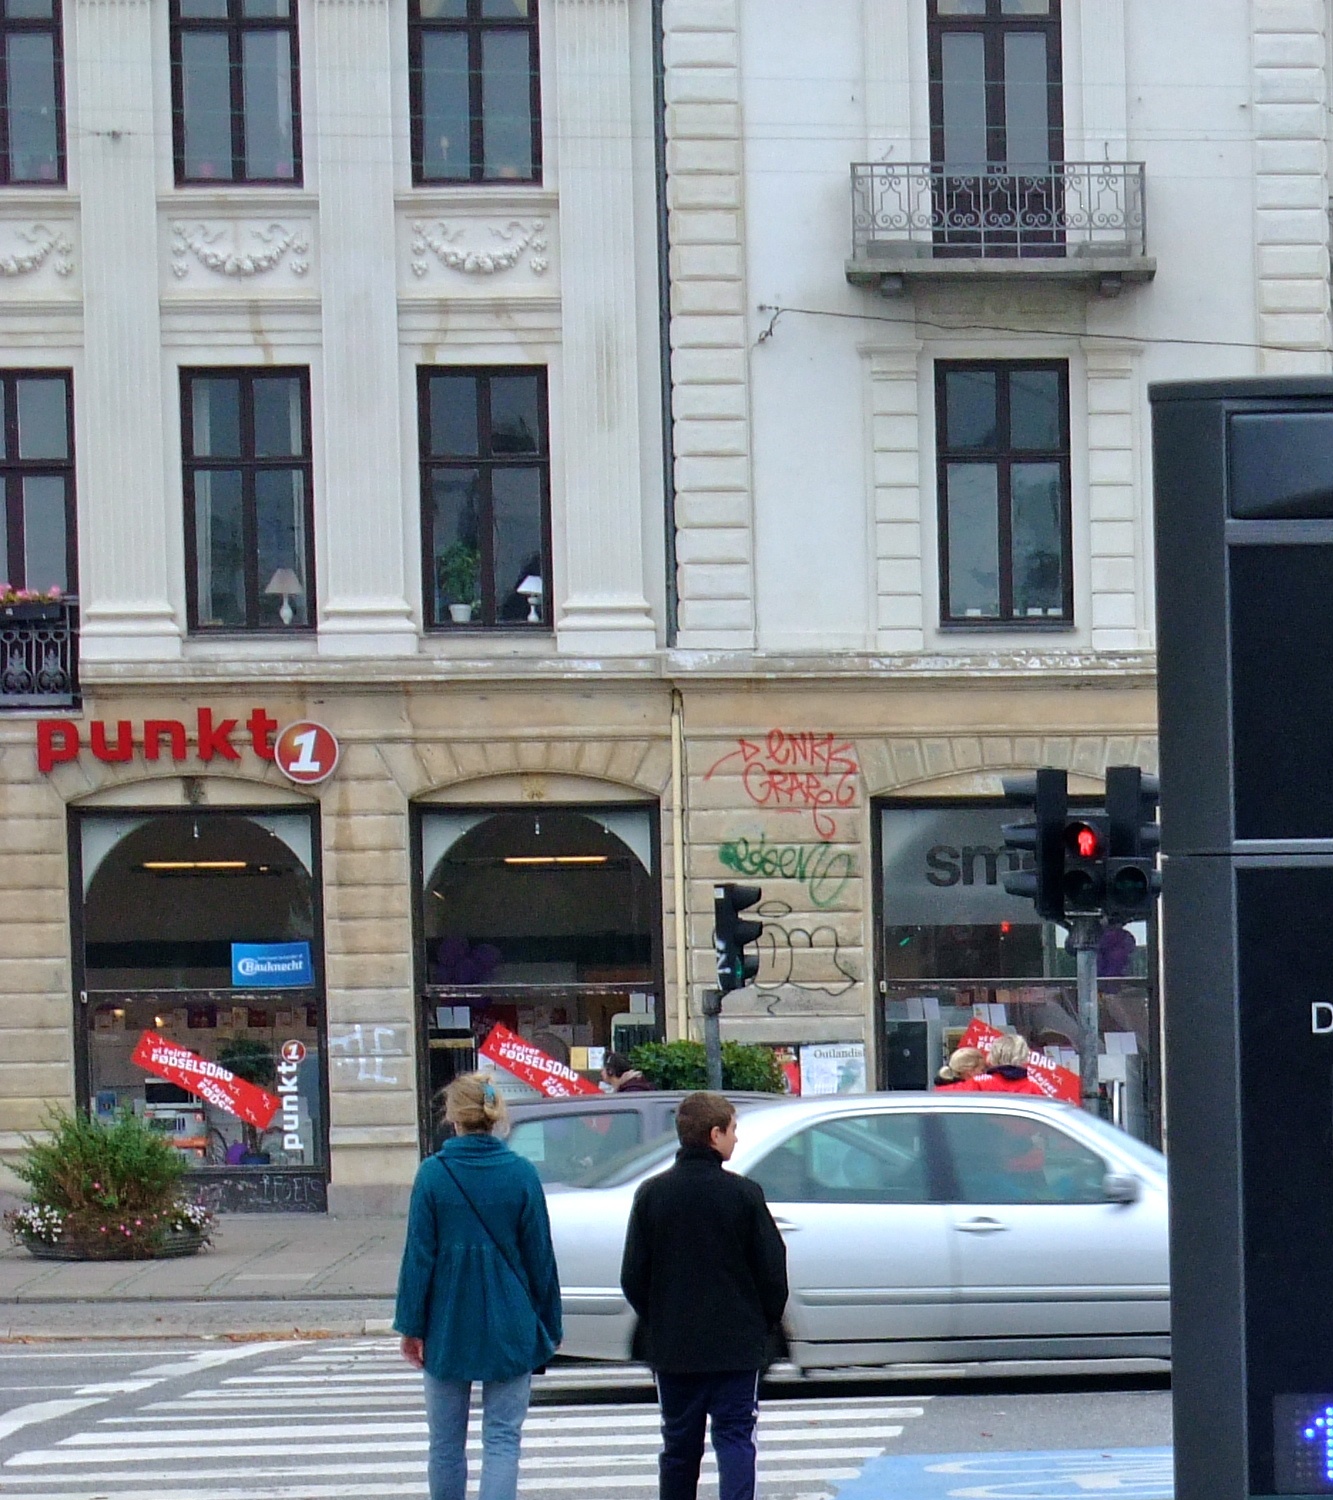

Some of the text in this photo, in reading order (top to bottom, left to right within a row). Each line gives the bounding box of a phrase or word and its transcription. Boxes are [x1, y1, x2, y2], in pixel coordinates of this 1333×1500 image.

[37, 707, 278, 772] punkt
[239, 958, 303, 974] Bauknecht
[277, 1062, 304, 1151] punkt
